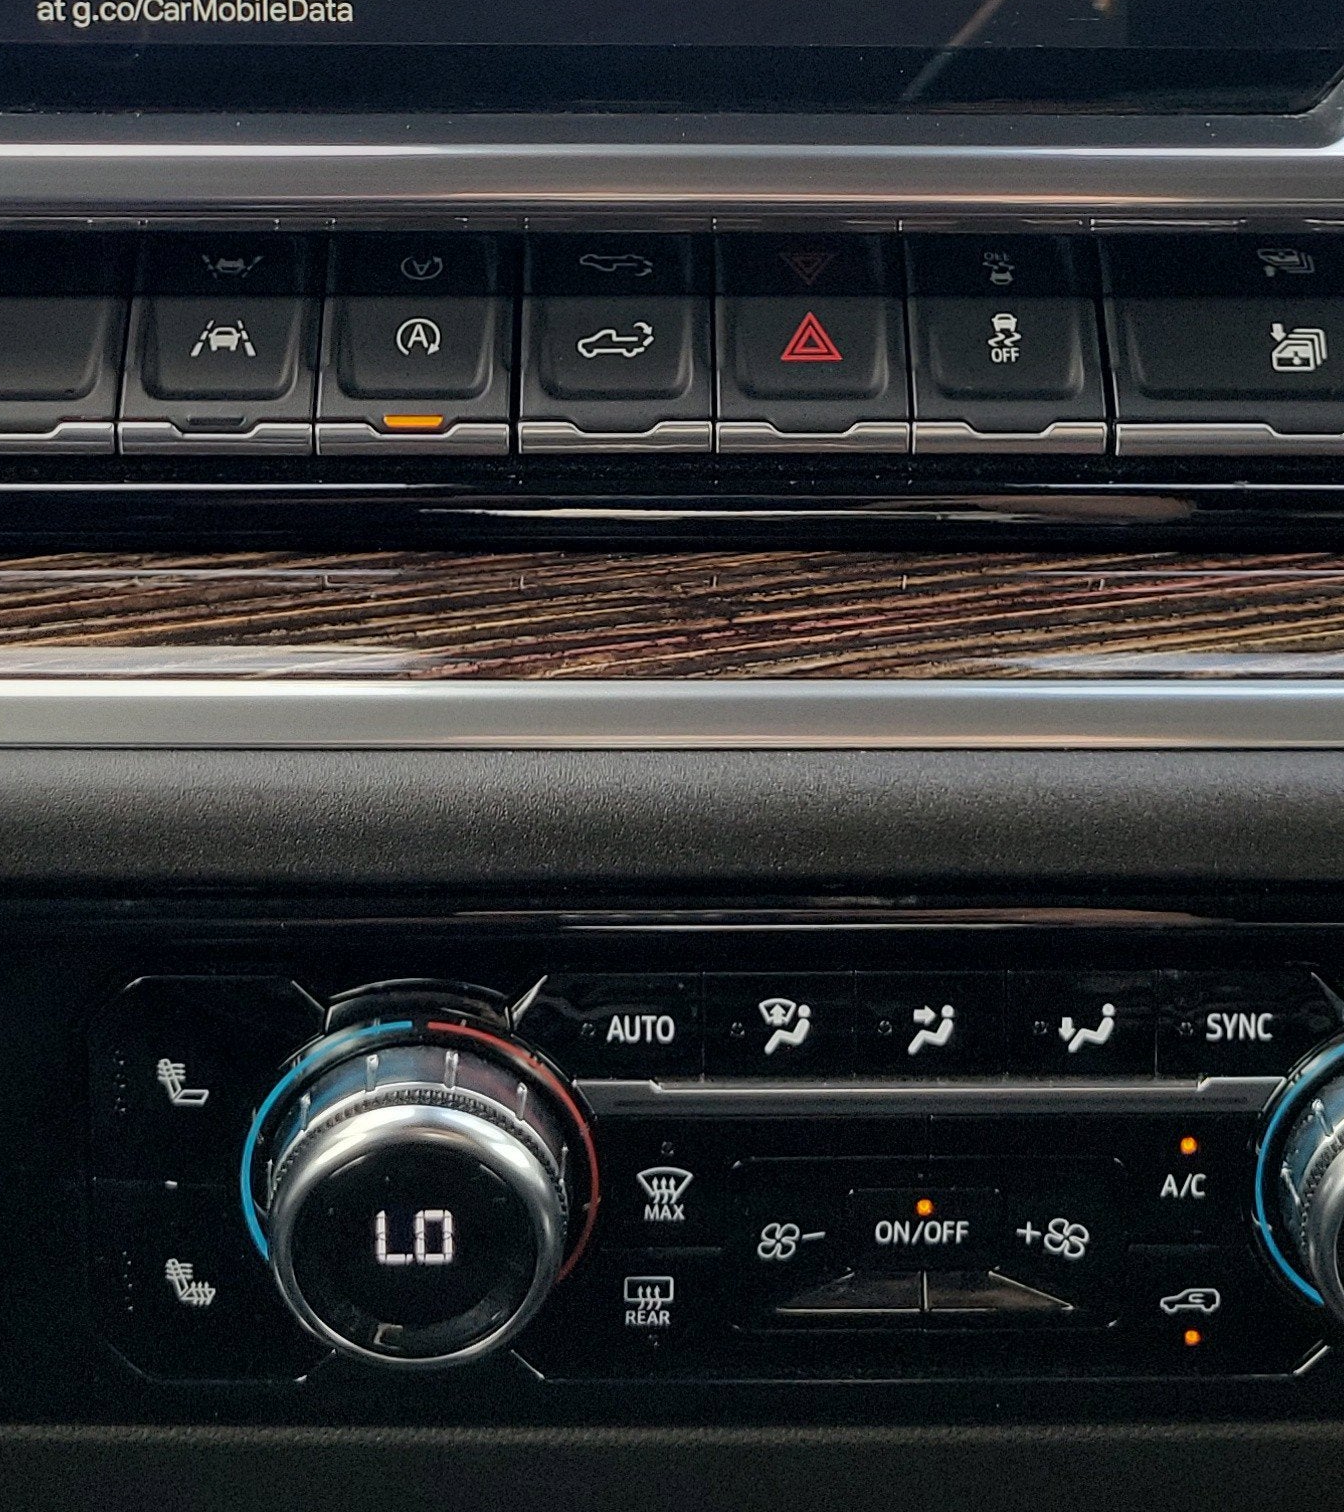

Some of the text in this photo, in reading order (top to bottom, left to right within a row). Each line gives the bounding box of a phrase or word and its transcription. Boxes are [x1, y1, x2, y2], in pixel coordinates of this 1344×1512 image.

[991, 347, 1020, 363] OFF
[606, 1015, 675, 1043] AUTO
[1205, 1013, 1273, 1041] SYNC
[1160, 1173, 1207, 1199] A/C
[643, 1204, 686, 1221] MAX
[375, 1209, 454, 1265] LO
[874, 1220, 969, 1244] ON/OFF
[625, 1309, 672, 1326] REAR
